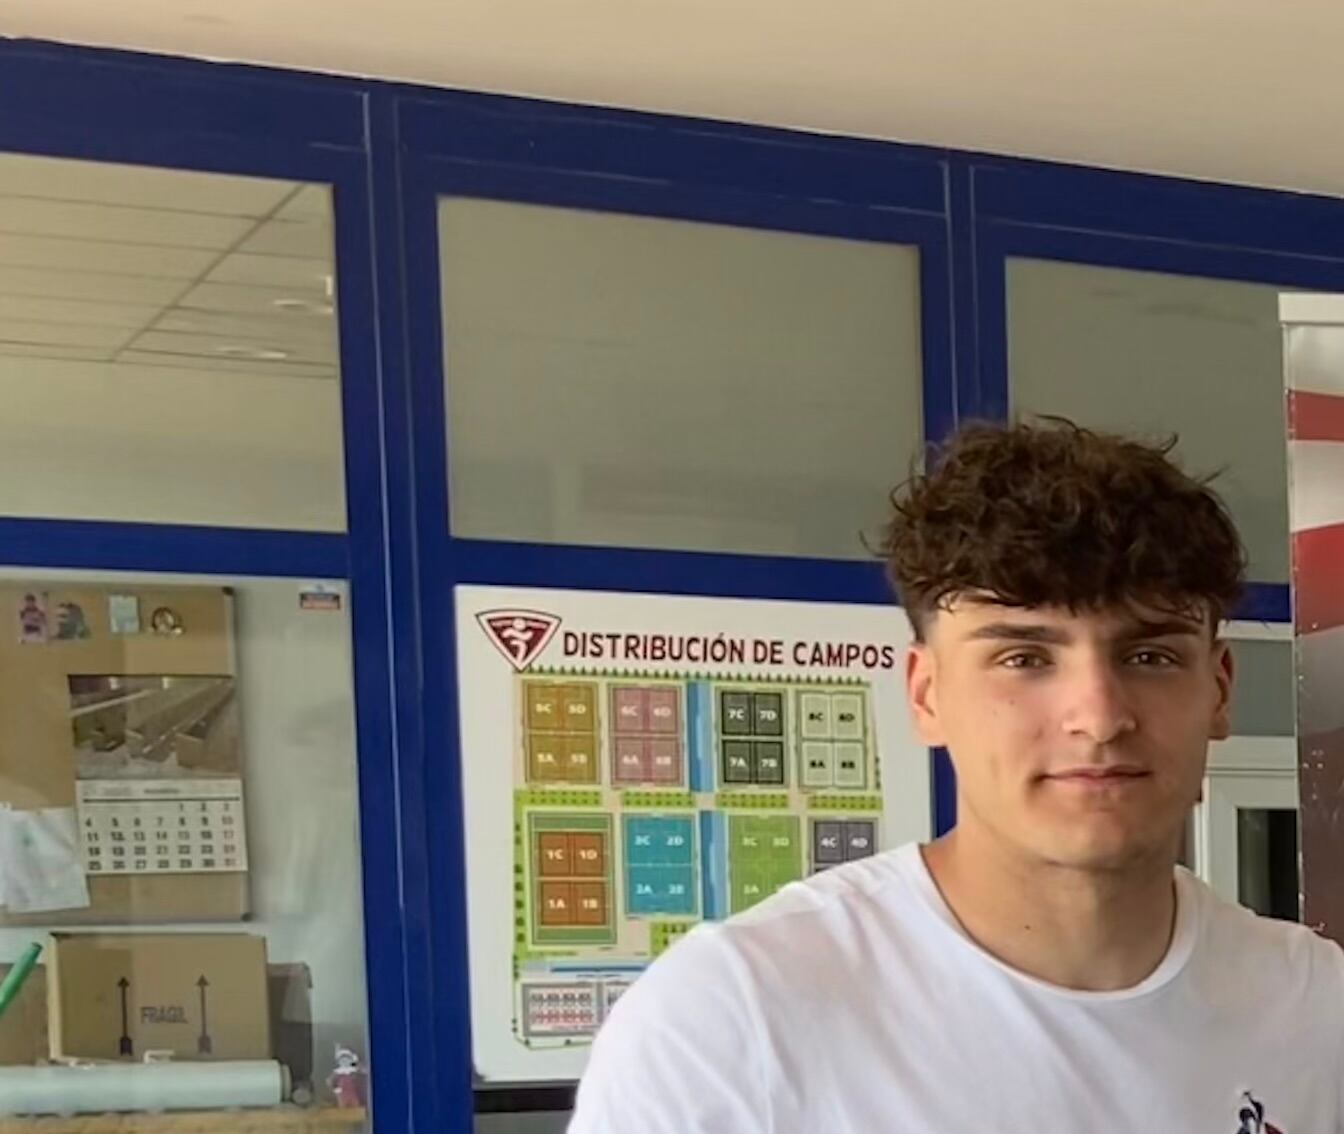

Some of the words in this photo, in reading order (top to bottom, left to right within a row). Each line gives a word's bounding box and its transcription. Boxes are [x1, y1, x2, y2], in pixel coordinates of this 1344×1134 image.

[563, 631, 745, 664] DISTRIBUCIÓN
[753, 639, 784, 665] DE
[793, 641, 895, 670] CAMPOS
[728, 709, 745, 720] 7C
[760, 710, 777, 721] 7D
[729, 757, 746, 768] 7A
